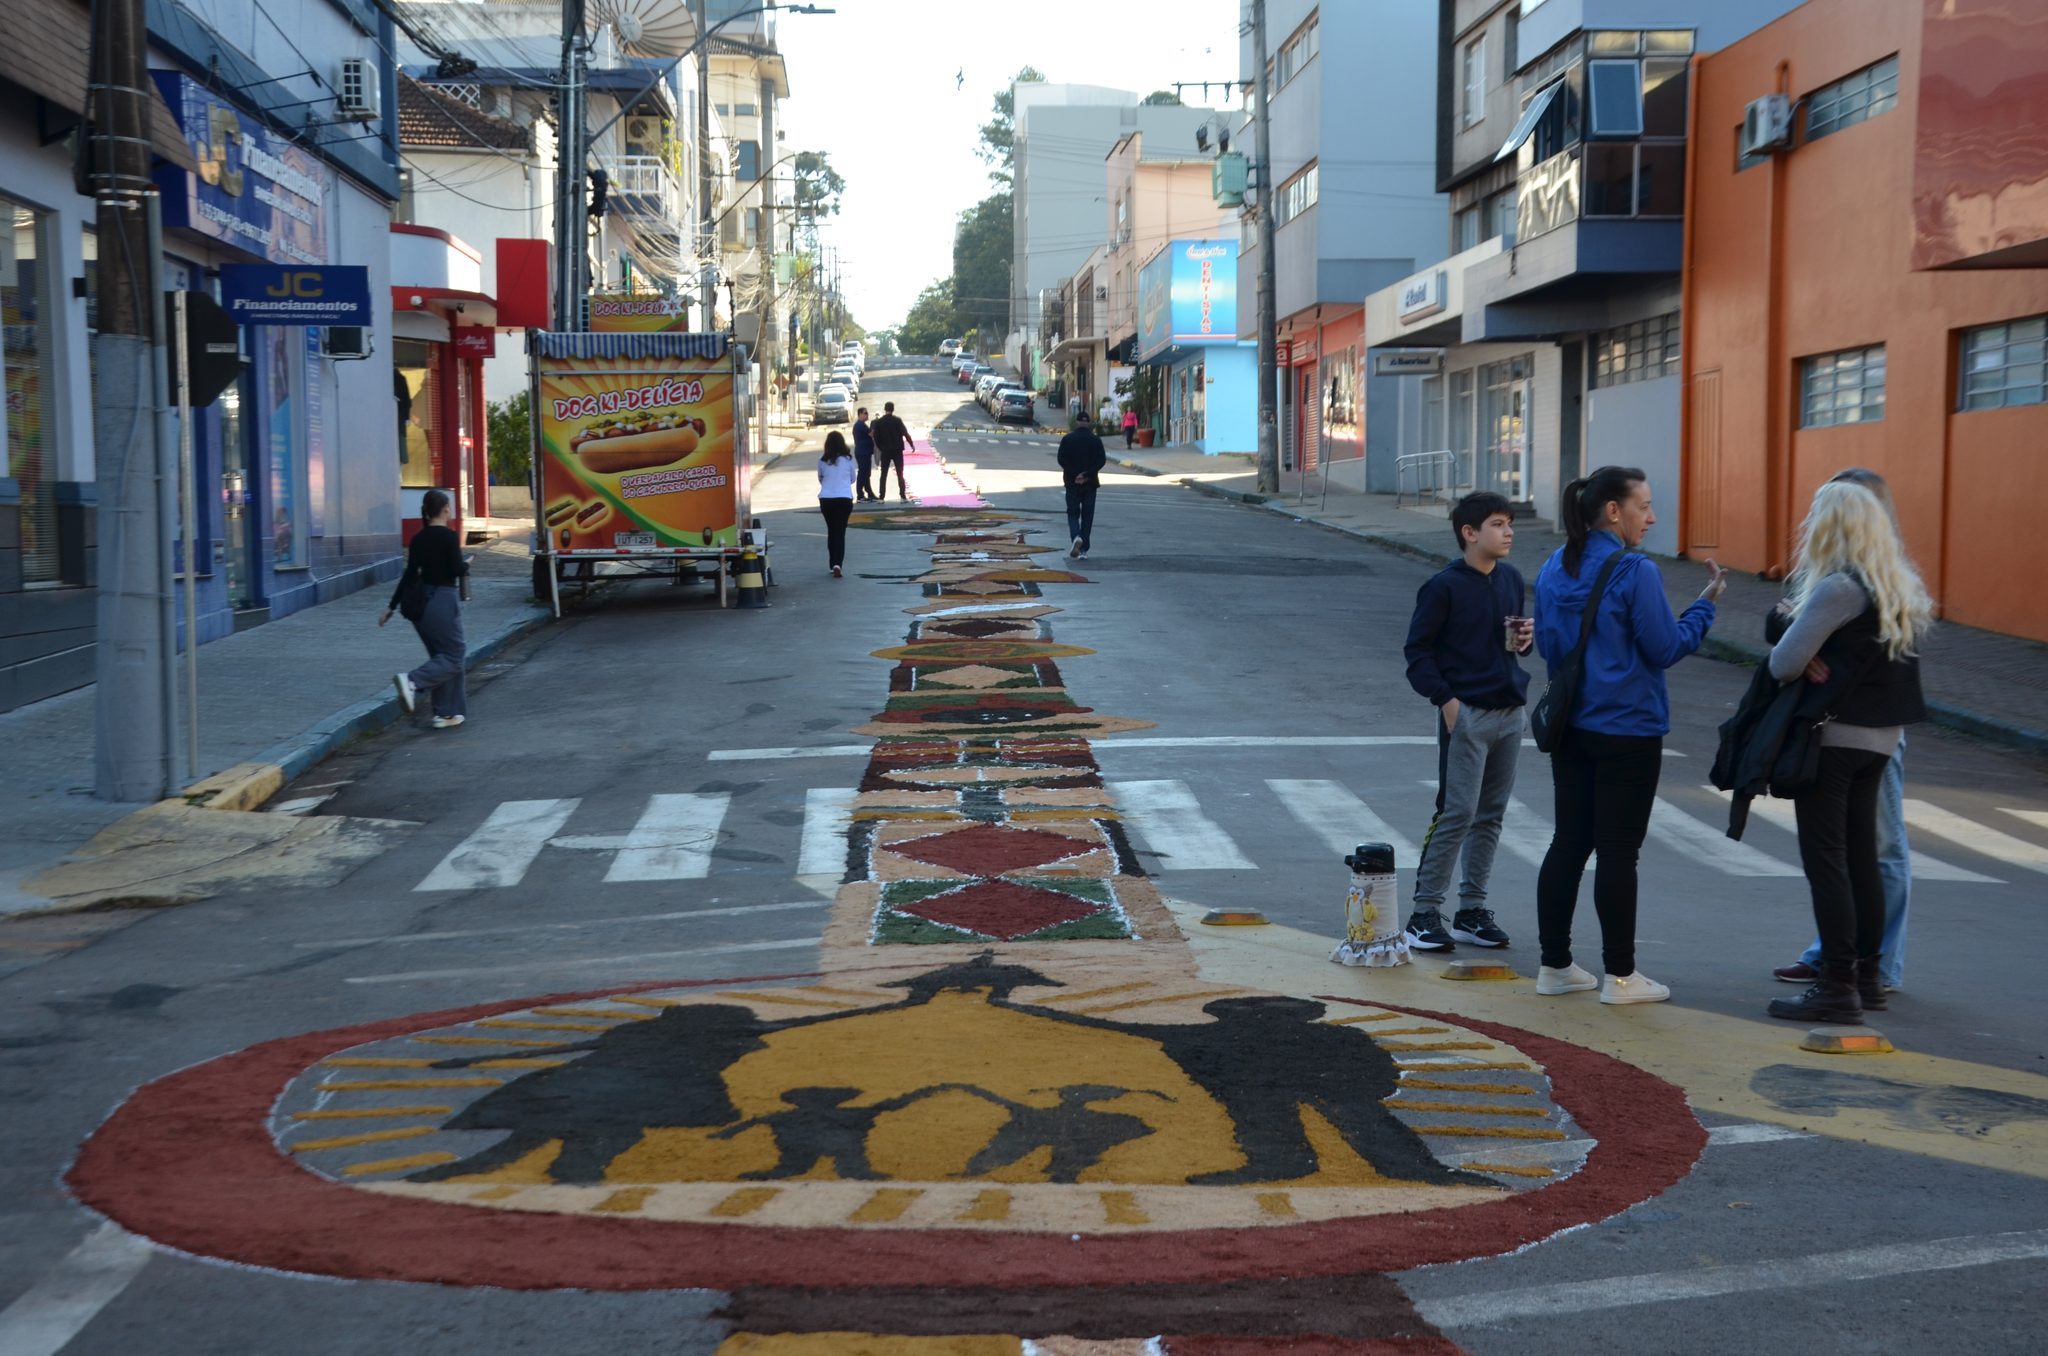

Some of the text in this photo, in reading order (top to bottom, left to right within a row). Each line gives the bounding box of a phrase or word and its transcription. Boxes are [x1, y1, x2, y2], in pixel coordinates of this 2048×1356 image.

[197, 101, 243, 197] JC
[266, 272, 324, 297] JC
[232, 299, 358, 312] Financiamentos
[1201, 260, 1212, 333] DENTISTAS
[594, 302, 620, 316] DOG
[554, 379, 704, 421] DOG KI-DELÍCIA
[621, 465, 717, 487] O VERDADEIRO SABOR
[623, 489, 636, 498] DO
